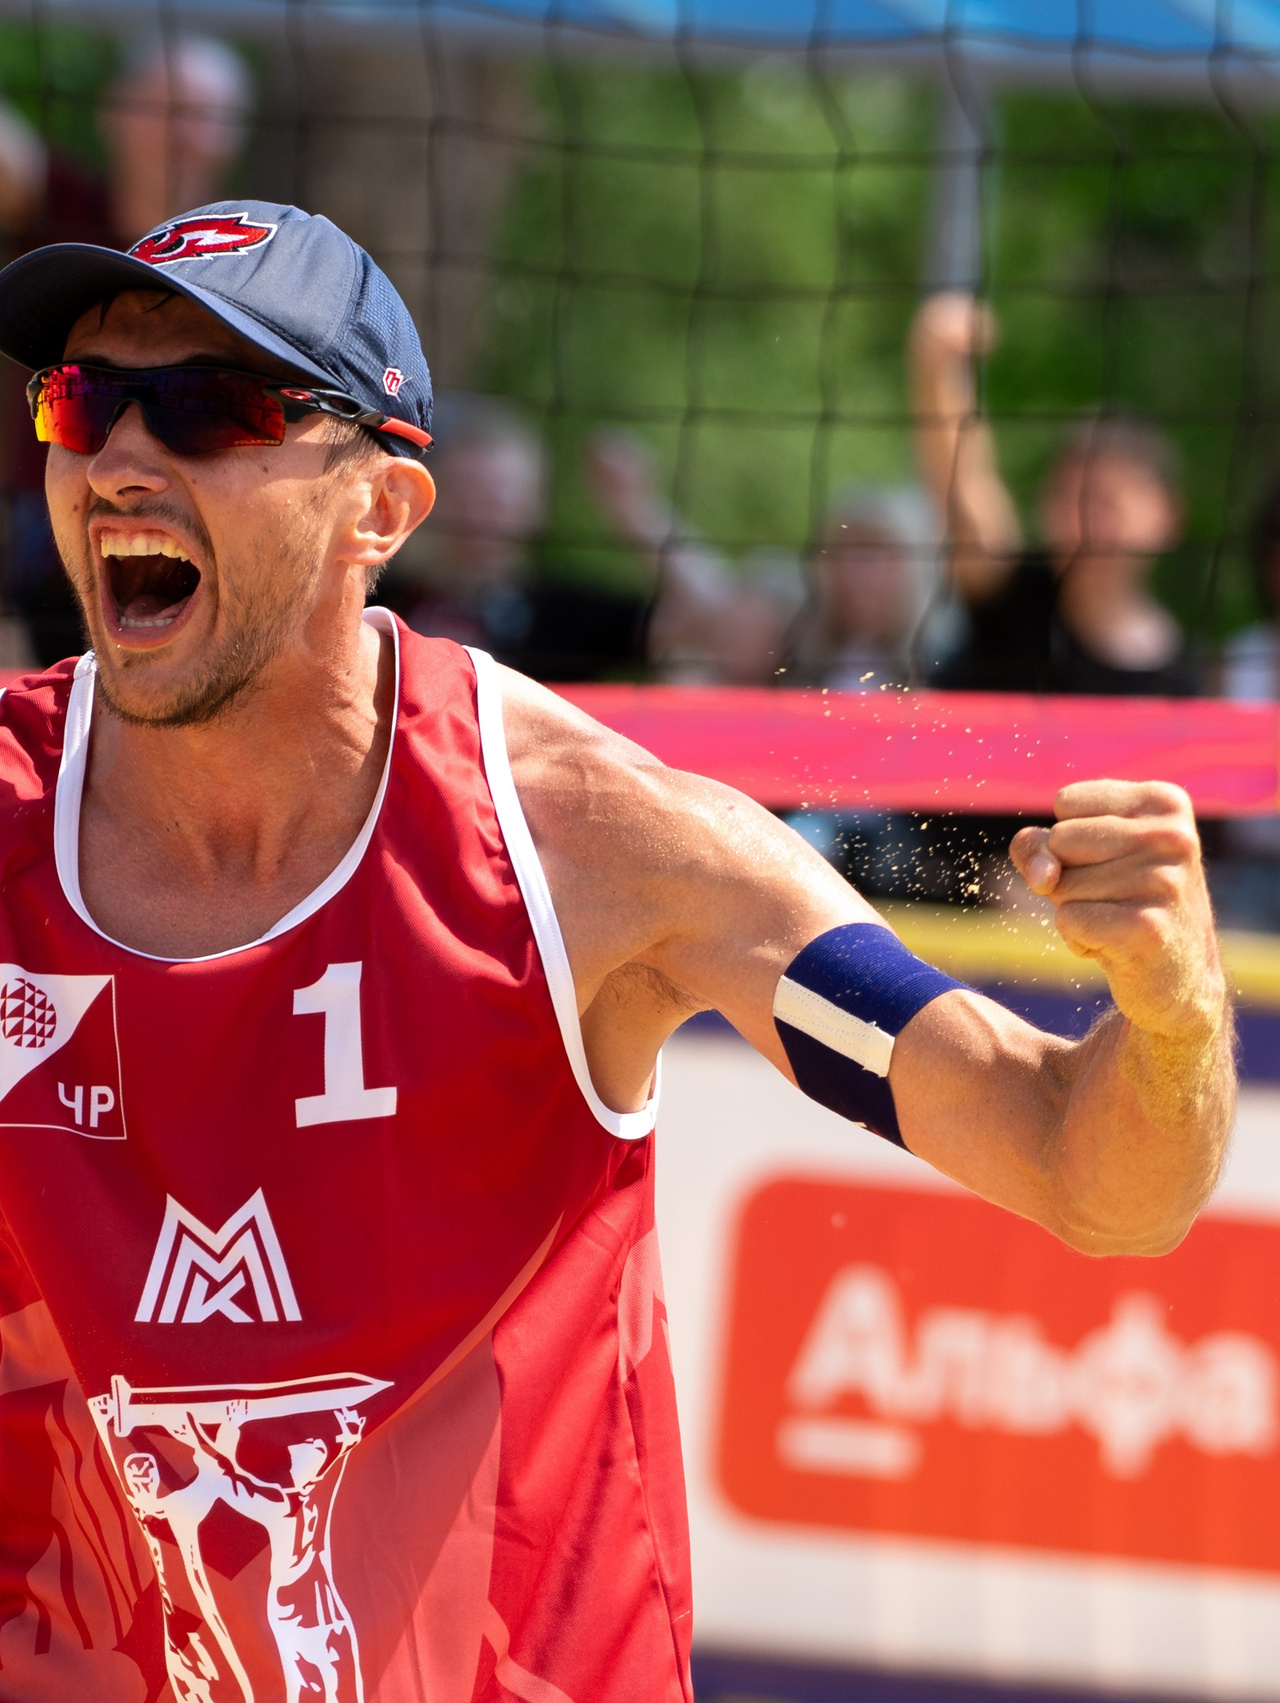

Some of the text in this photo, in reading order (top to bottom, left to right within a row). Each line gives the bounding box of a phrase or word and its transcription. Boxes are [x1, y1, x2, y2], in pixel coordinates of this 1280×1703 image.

[57, 1082, 115, 1128] ЧР
[293, 961, 397, 1129] 1
[788, 1264, 1279, 1476] Альфа
